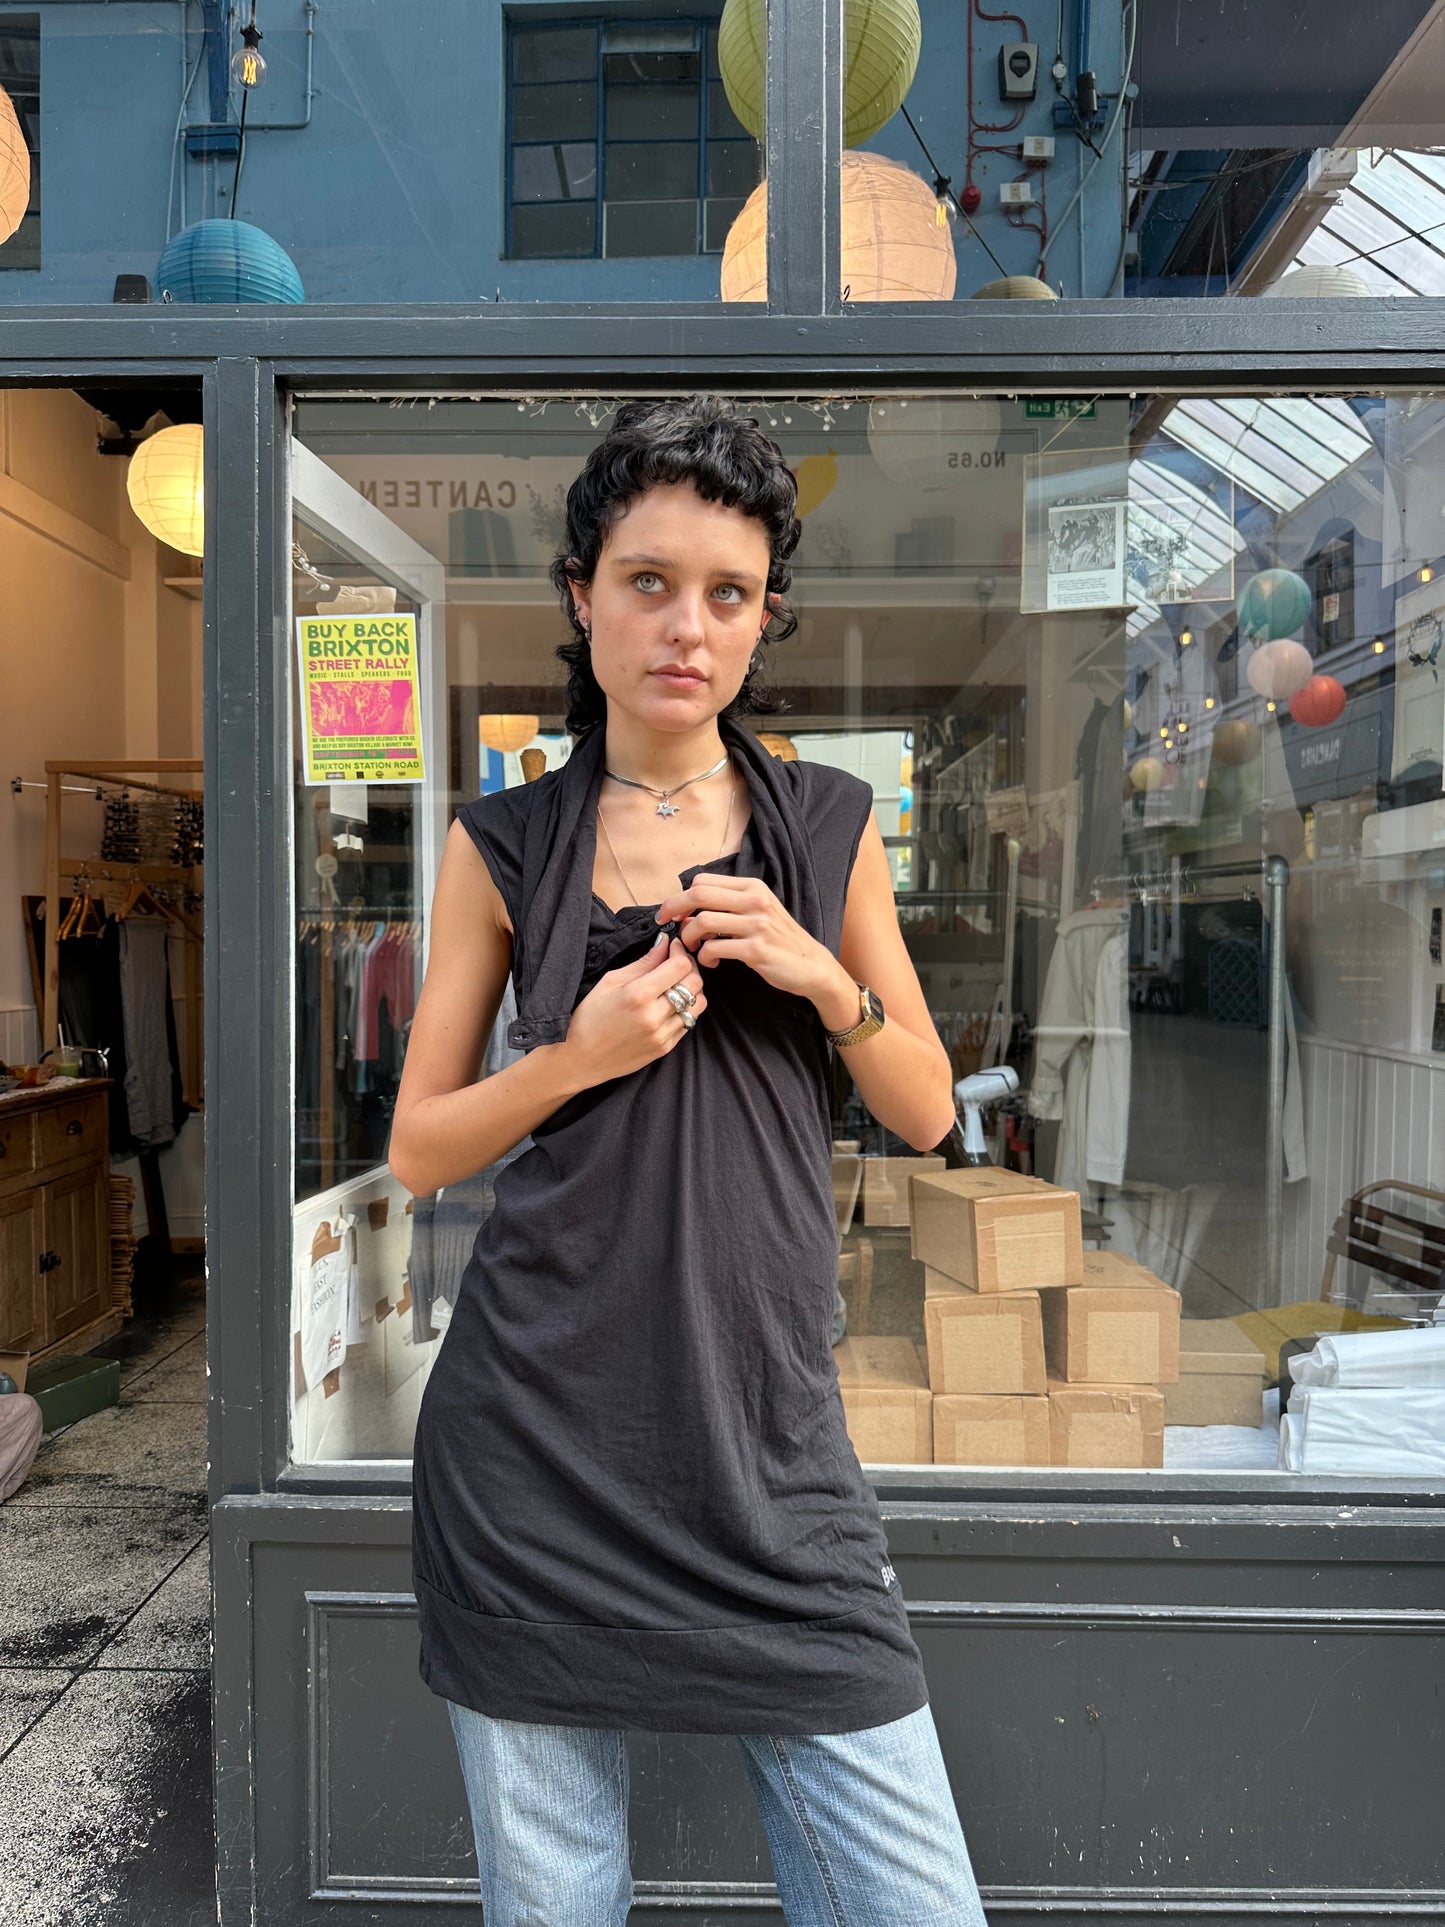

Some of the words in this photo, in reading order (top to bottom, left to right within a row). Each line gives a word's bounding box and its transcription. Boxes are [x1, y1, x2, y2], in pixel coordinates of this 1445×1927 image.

[308, 624, 346, 638] BUY
[354, 623, 408, 637] BACK
[309, 639, 409, 657] BRIXTON
[309, 660, 360, 671] STREET
[366, 658, 408, 669] RALLY
